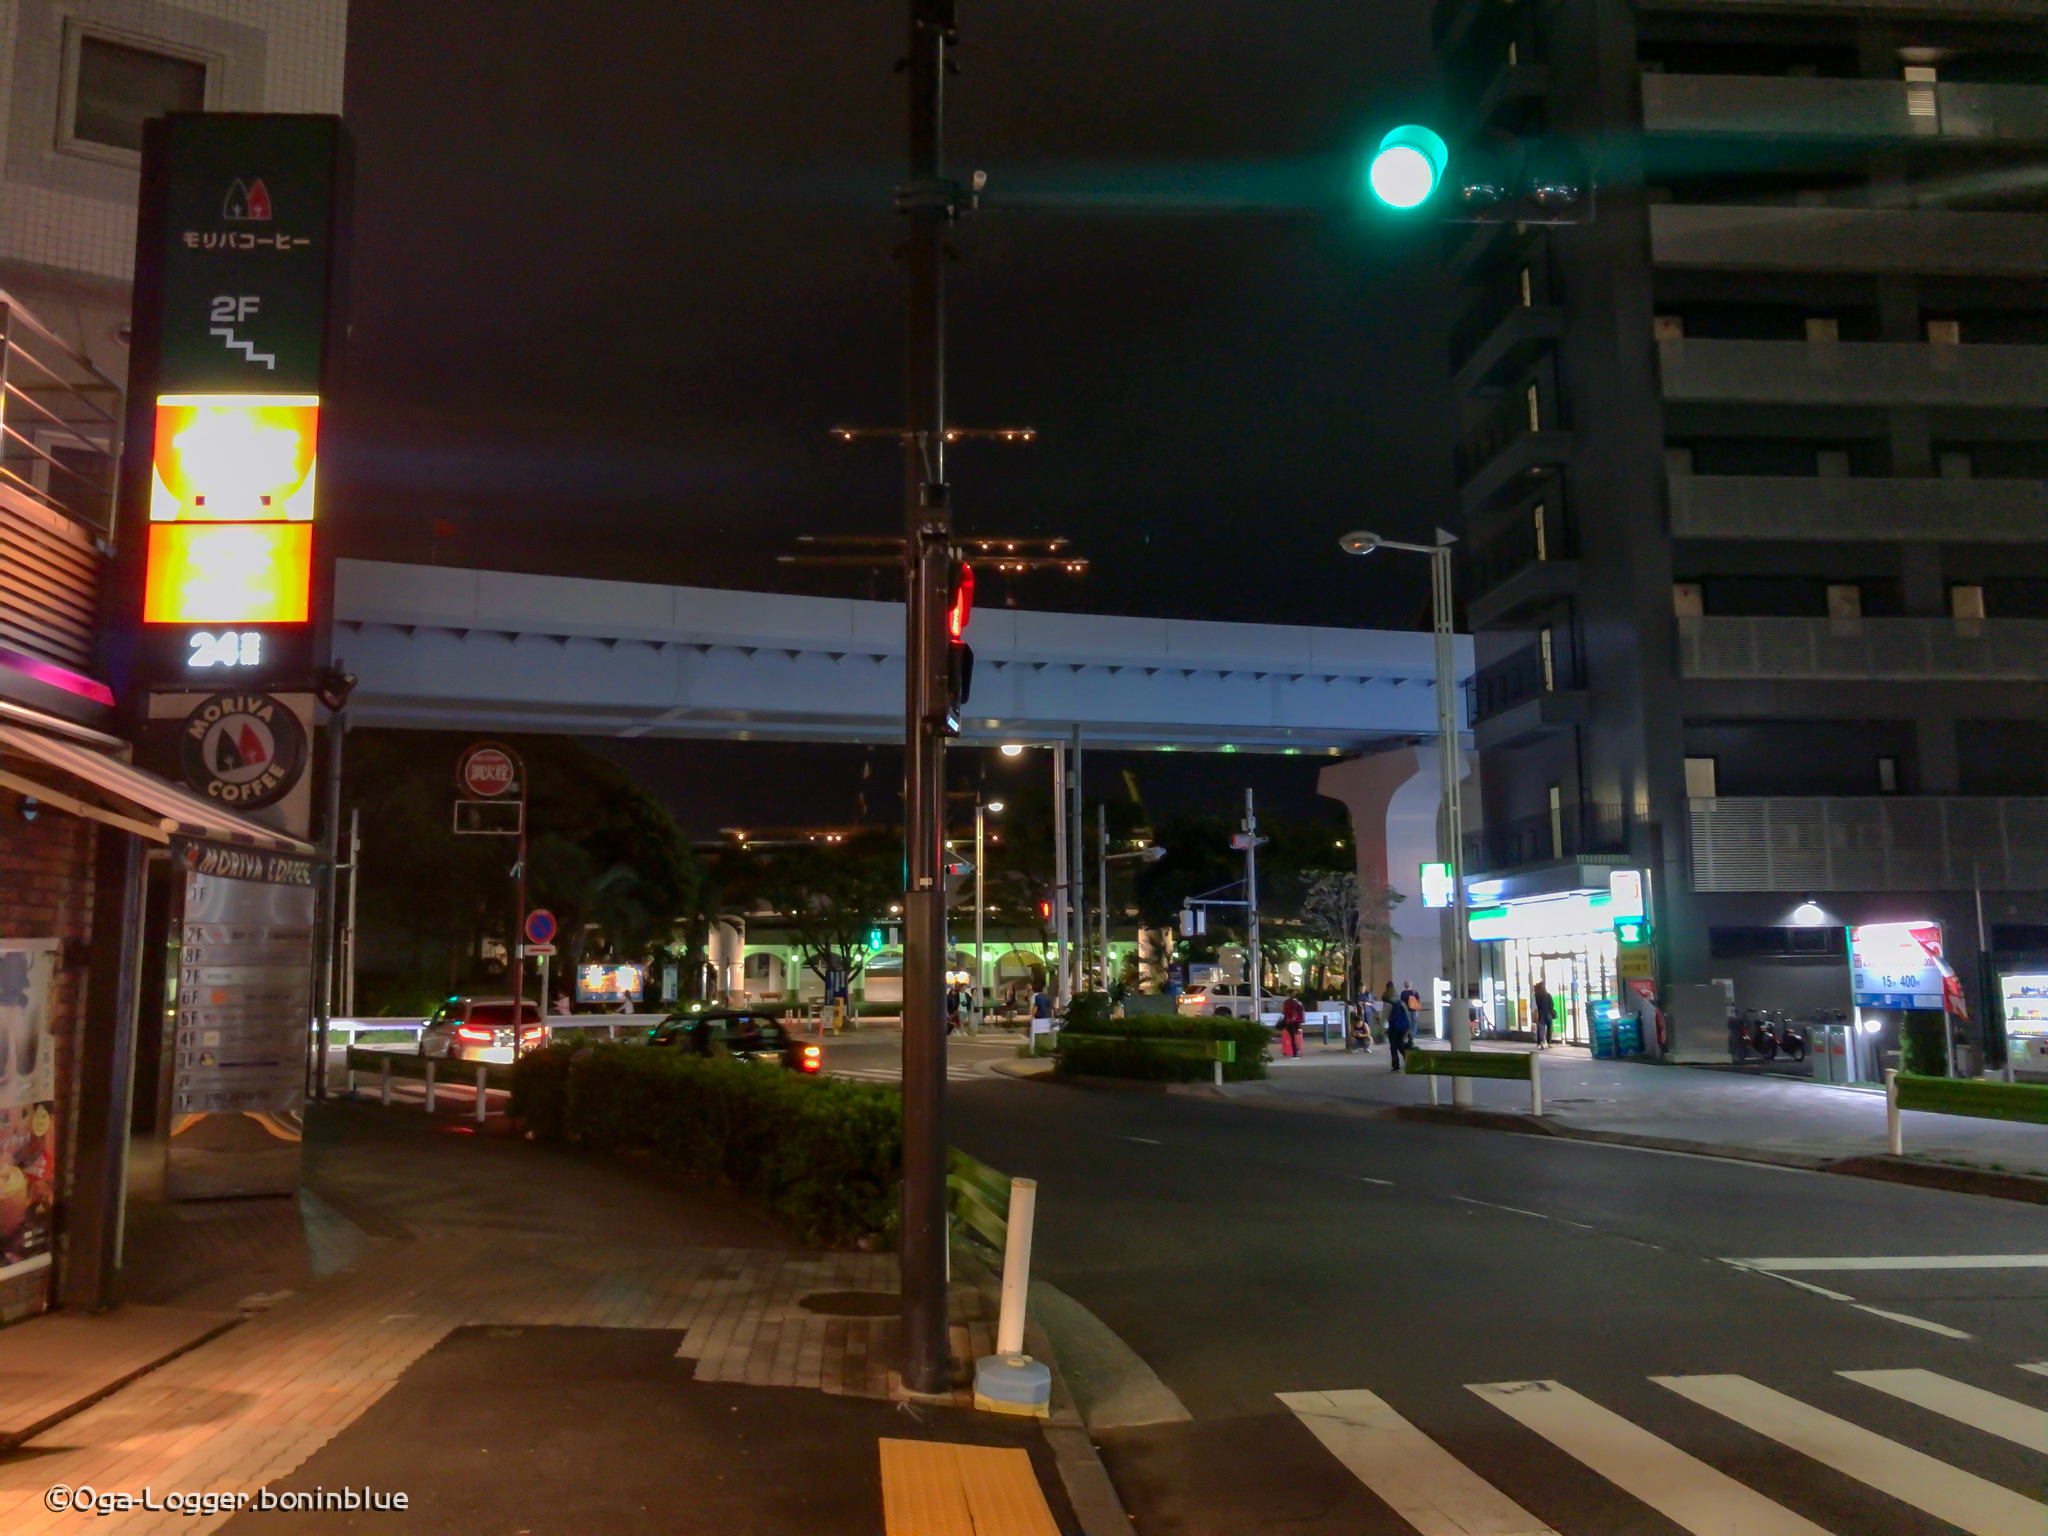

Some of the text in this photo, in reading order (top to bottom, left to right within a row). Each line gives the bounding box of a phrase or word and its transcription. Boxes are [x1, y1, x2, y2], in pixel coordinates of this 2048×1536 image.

[183, 231, 310, 250] モリバコーヒー
[210, 296, 260, 323] 2F
[188, 695, 275, 741] MORIVA
[207, 763, 286, 802] COFFEE
[471, 764, 509, 781] 消火栓
[198, 847, 312, 885] MORIVA COFFEE
[187, 927, 204, 943] 2F
[185, 948, 202, 963] 8F
